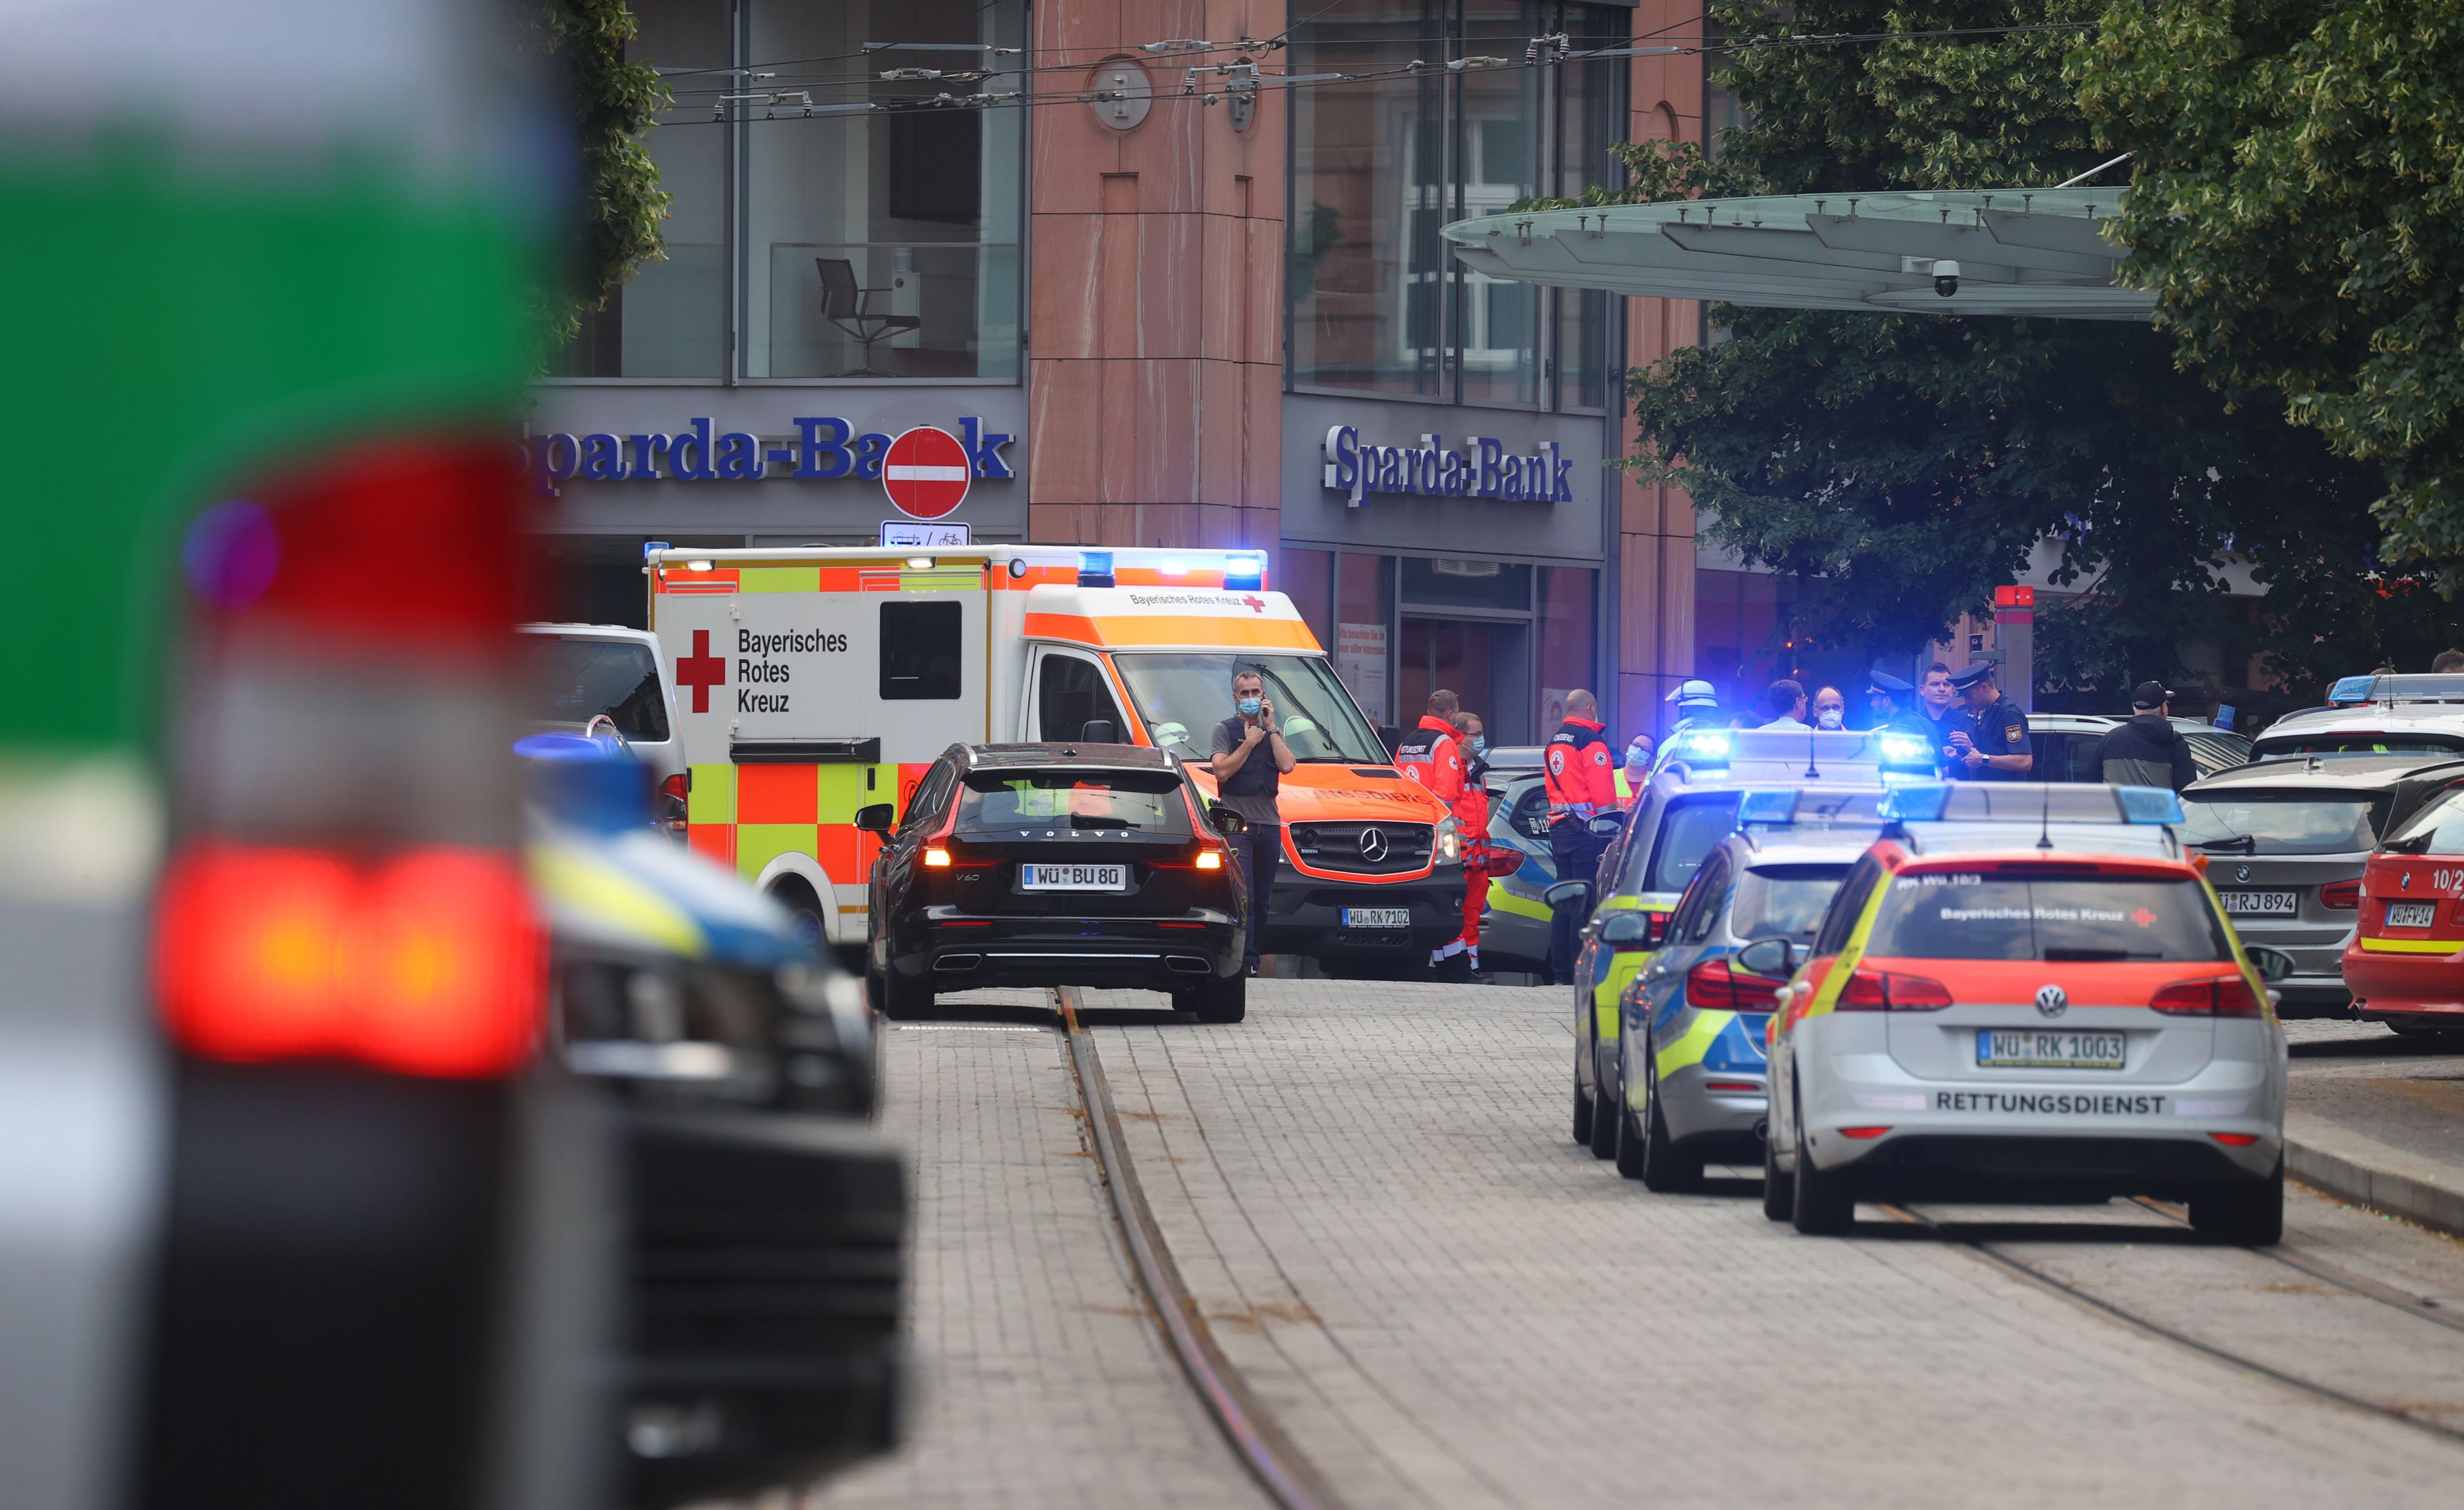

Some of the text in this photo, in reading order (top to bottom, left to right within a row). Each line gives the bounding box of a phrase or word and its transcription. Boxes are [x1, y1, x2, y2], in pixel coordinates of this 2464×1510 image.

[515, 416, 1015, 496] parda-Bak
[1325, 425, 1572, 508] Sparda-Bank
[1130, 594, 1242, 606] Bayerisches Rotes Kreuz
[739, 628, 847, 658] Bayerisches
[739, 659, 790, 683] Rotes
[738, 689, 789, 713] Kreuz
[1539, 819, 1550, 833] 11
[1038, 867, 1059, 884] WÜ
[1072, 867, 1094, 884] BU
[1098, 867, 1118, 884] 80
[2239, 894, 2261, 911] RJ
[2264, 894, 2293, 910] 894
[1349, 911, 1409, 924] WÜ RK 7102
[1940, 907, 2125, 922] Bayerisches Rotes Kreuz
[1993, 1035, 2120, 1059] WÜ RK 1003
[1937, 1092, 2165, 1114] RETTUNGSDIENST
